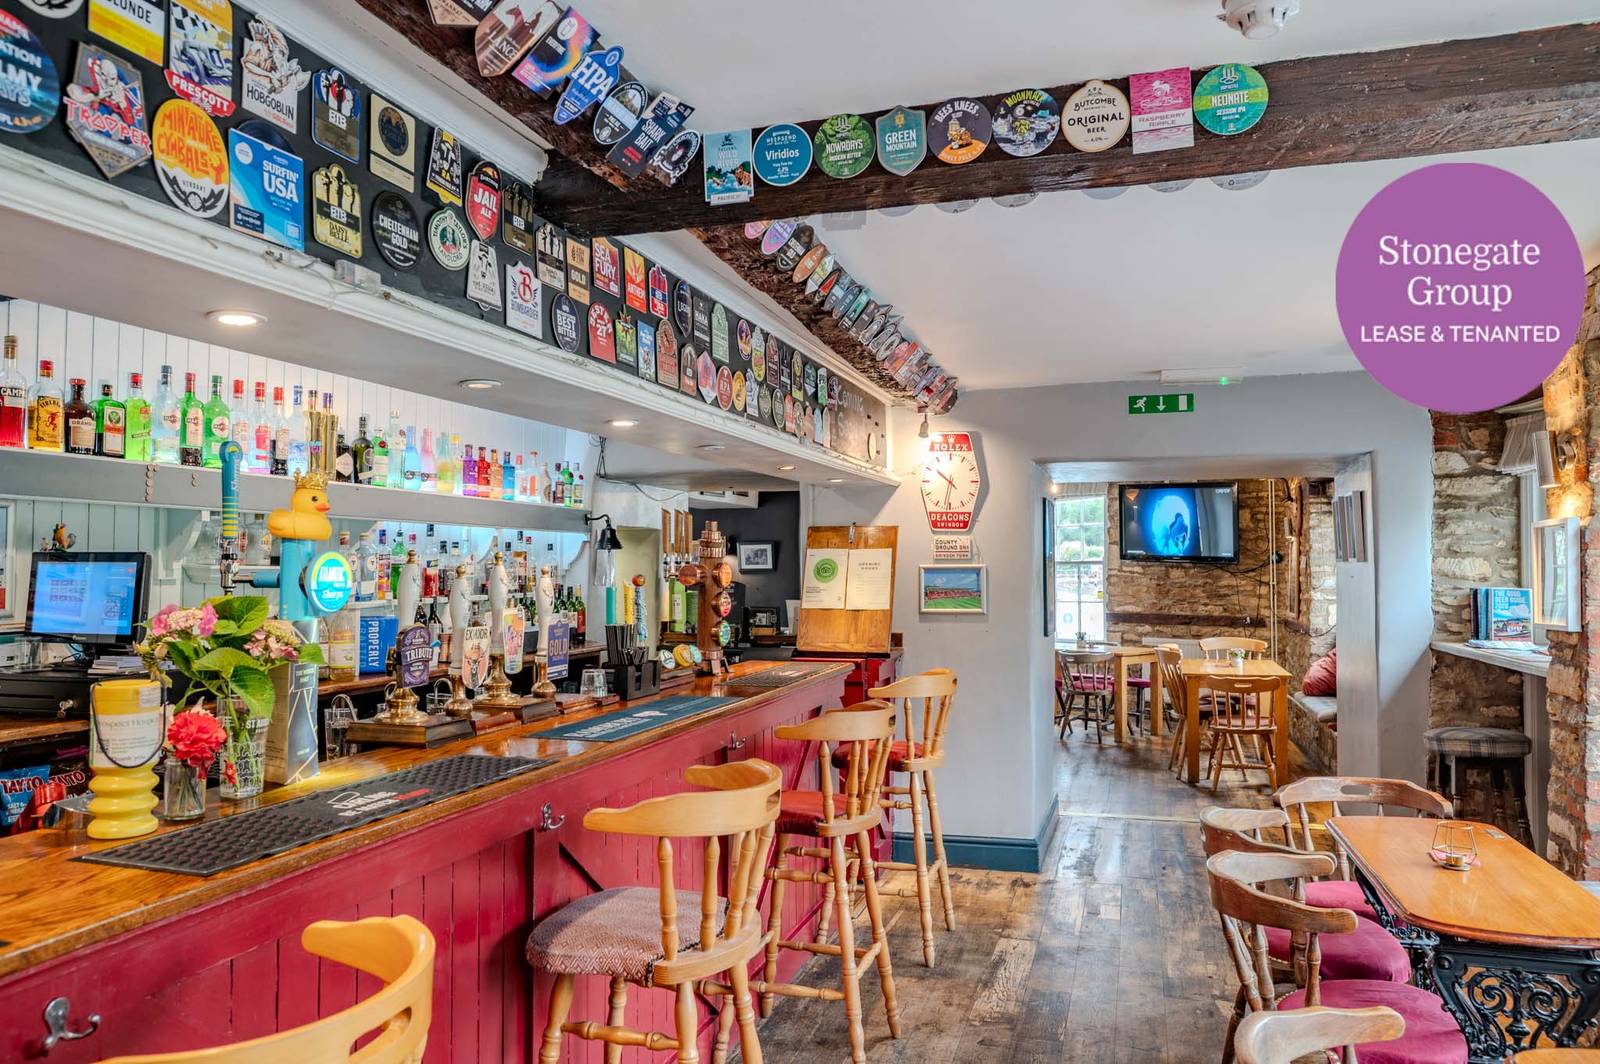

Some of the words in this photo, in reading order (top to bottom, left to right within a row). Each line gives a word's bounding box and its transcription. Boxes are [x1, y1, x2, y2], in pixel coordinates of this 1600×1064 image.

[106, 0, 151, 24] LONDE
[571, 55, 614, 103] HPA
[171, 75, 229, 112] PRESCOTT
[246, 83, 295, 120] HOBGOBLIN
[1211, 91, 1249, 107] NEONATE
[934, 103, 954, 123] BEES
[954, 100, 980, 115] KNEES
[1073, 97, 1117, 112] BUTCOMBE
[63, 96, 152, 153] TROOPER
[1067, 112, 1125, 127] ORIGINAL
[1138, 112, 1185, 123] RASPBERRY
[641, 119, 667, 143] SHARK
[885, 129, 917, 144] GREEN
[1087, 126, 1106, 134] BEER
[634, 132, 655, 151] BAIT
[826, 139, 864, 153] NOWADAYS
[885, 141, 917, 153] MOUNTAIN
[765, 149, 800, 160] Viridios
[262, 160, 299, 182] SURFIN'
[262, 171, 299, 204] USA
[473, 187, 497, 213] JAIL
[480, 207, 492, 220] ALE
[379, 214, 418, 243] CHELTENHAM
[391, 232, 408, 249] GOLD
[594, 243, 612, 263] SEA
[571, 269, 586, 285] GOLD
[594, 258, 616, 281] FURY
[557, 312, 576, 331] BEST
[557, 325, 577, 340] BITTER
[934, 443, 968, 451] ROLEX
[931, 513, 970, 521] DEACONS
[368, 620, 379, 668] PROPERLY
[465, 628, 489, 641] EXMOOR
[406, 648, 433, 661] TRIBUTE
[549, 638, 568, 657] GOLD
[1, 775, 43, 794] TAYTO
